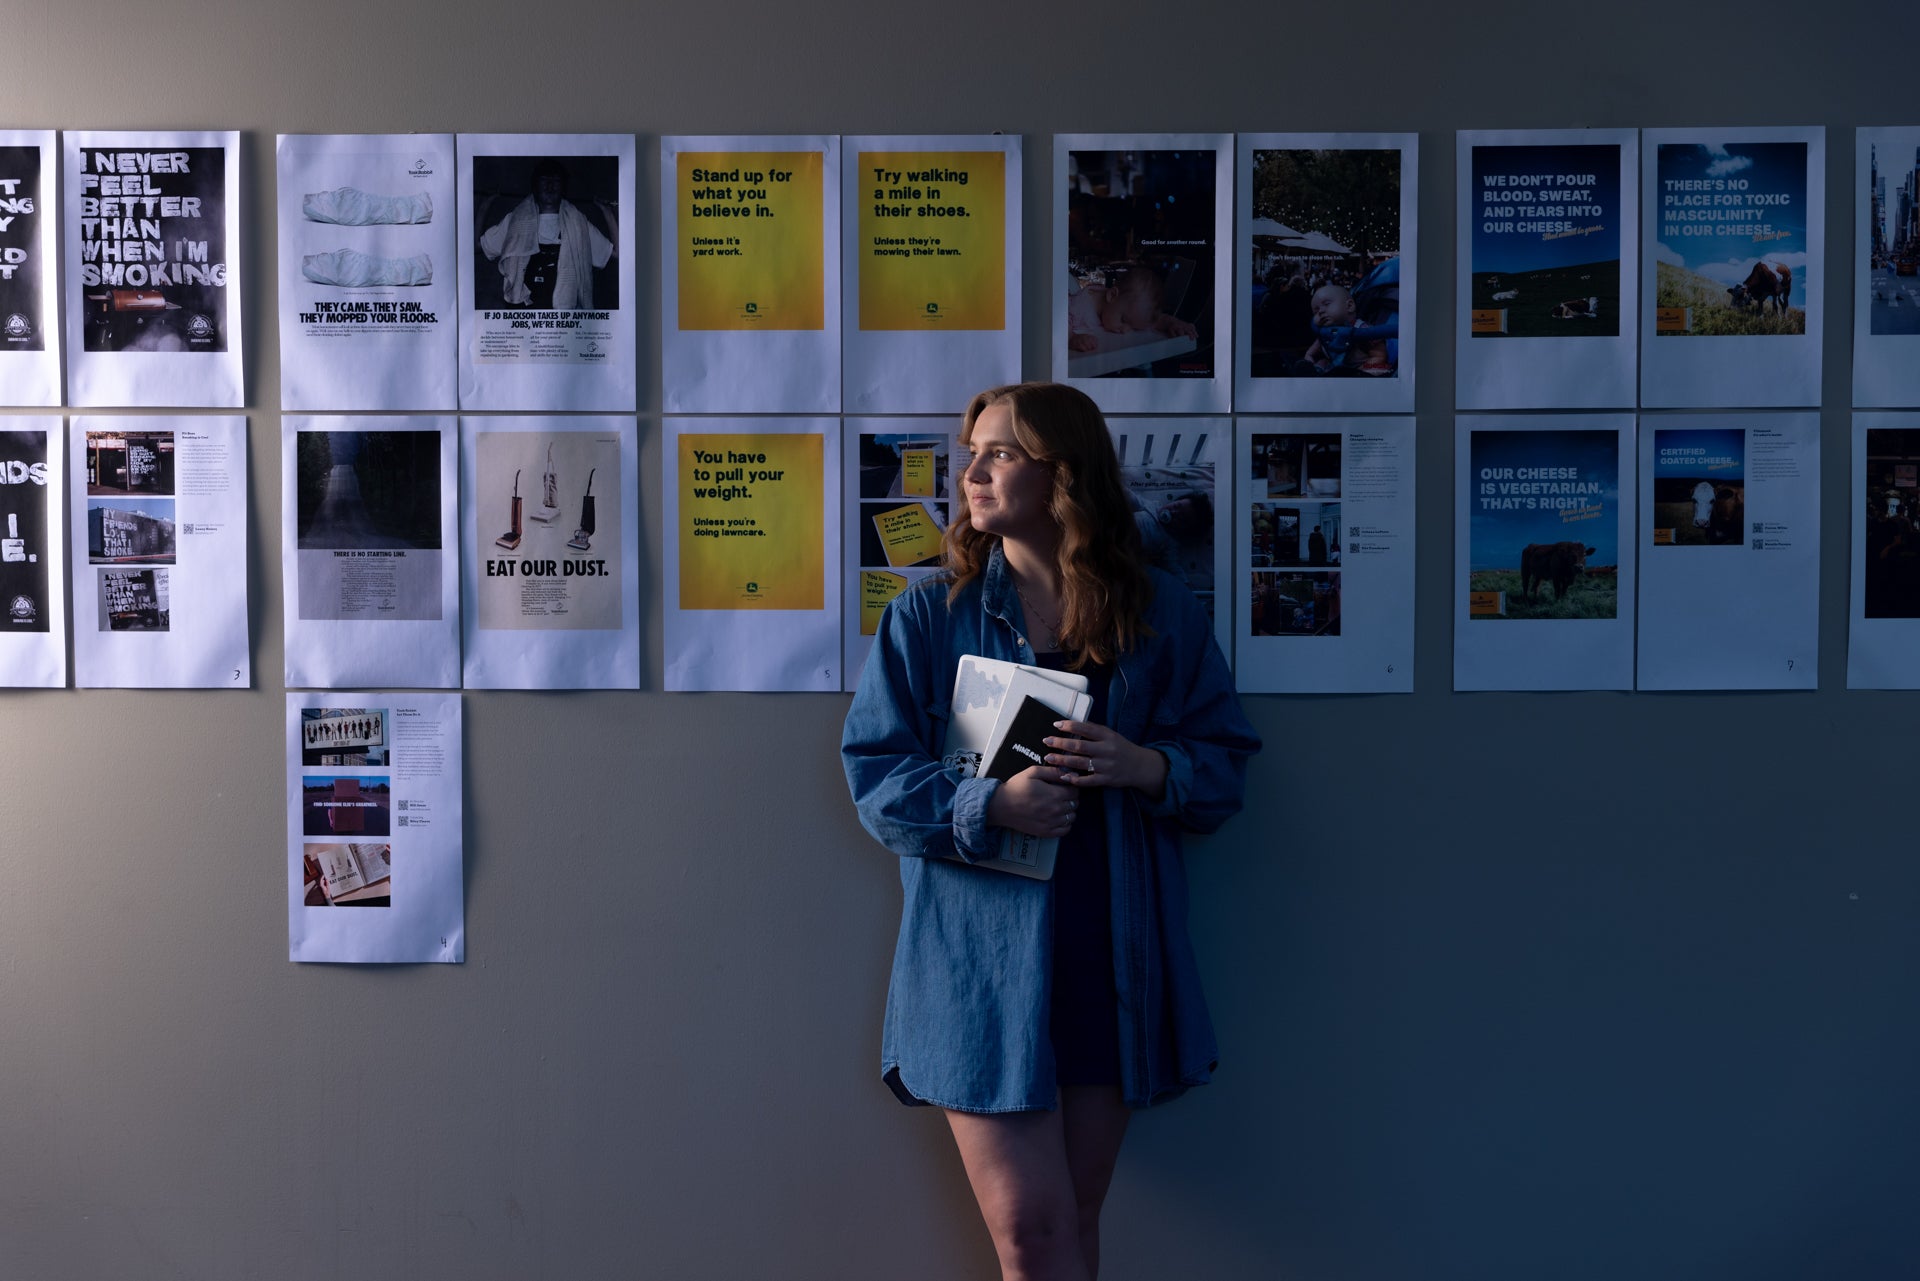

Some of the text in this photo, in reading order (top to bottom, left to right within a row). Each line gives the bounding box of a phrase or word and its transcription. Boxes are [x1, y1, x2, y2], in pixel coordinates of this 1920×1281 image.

[80, 152, 190, 173] I NEVER
[692, 169, 792, 185] Stand up for
[874, 169, 968, 185] Try walking
[1483, 175, 1596, 186] WE DON'T POUR
[81, 175, 161, 195] FEEL
[1665, 180, 1748, 191] THERE'S NO
[692, 186, 766, 203] what you
[874, 186, 940, 200] a mile in
[1483, 190, 1592, 202] BLOOD, SWEAT,
[1665, 194, 1790, 206] PLACE FOR TOXIC
[81, 196, 201, 217] BETTER
[693, 204, 774, 217] believe in.
[874, 204, 970, 217] their shoes.
[1483, 206, 1602, 217] AND TEARS INTO
[1665, 210, 1764, 221] MASCULINITY
[82, 218, 160, 239] THAN
[1483, 222, 1513, 233] OUR
[1665, 225, 1679, 236] IN
[1682, 225, 1712, 236] OUR
[726, 237, 740, 245] it's
[874, 237, 940, 248] Unless they're
[82, 238, 208, 262] WHEN I'M
[693, 248, 714, 257] yard
[874, 249, 910, 257] mowing
[83, 263, 228, 286] SMOKING
[315, 302, 339, 312] THEY
[400, 302, 423, 312] SAW.
[300, 313, 438, 323] THEY MOPPED YOUR FLOORS.
[694, 451, 766, 464] You have
[0, 460, 47, 485] DS
[694, 468, 784, 484] to pull your
[1481, 468, 1577, 480] OUR CHEESE
[694, 485, 752, 500] weight.
[1481, 482, 1603, 494] IS VEGETARIAN.
[1481, 498, 1536, 510] THAT'S
[103, 519, 137, 530] FRIENDS
[694, 518, 756, 528] Unless you're
[694, 529, 719, 538] doing
[104, 538, 127, 547] THAT
[487, 559, 609, 577] EAT OUR DUST.
[108, 602, 158, 613] SMOKING
[1387, 664, 1393, 674] 6
[1787, 660, 1794, 671] 7
[234, 670, 240, 680] 3
[824, 670, 831, 679] 5
[441, 937, 446, 947] 4
